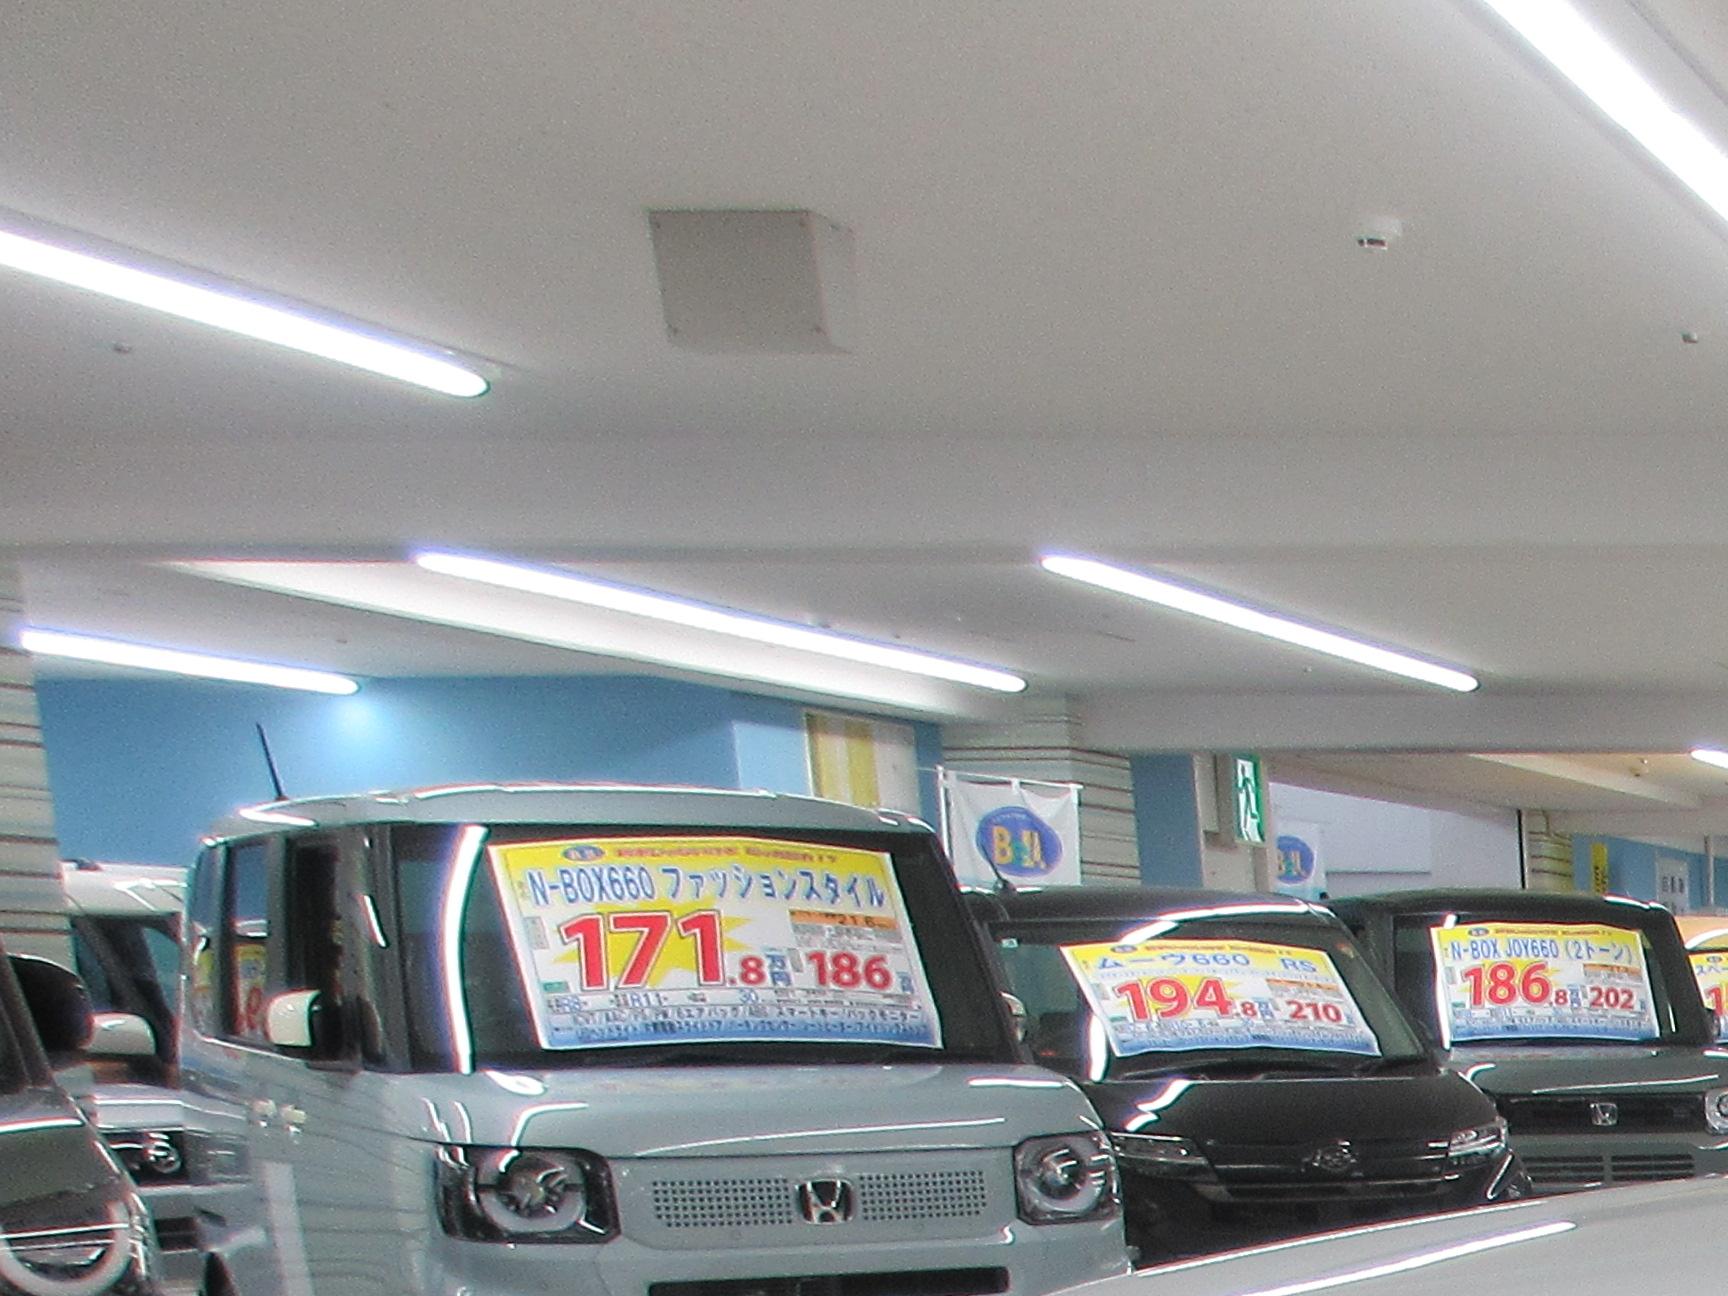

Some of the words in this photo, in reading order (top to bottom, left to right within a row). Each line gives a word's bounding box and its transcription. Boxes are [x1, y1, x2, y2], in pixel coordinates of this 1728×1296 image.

[527, 864, 656, 906] N-BOX660
[662, 864, 885, 908] ファッションスタイル
[1450, 941, 1502, 960] N-BOX
[1506, 939, 1559, 959] JOY660
[807, 951, 893, 991] 186
[1280, 957, 1317, 973] RS
[1590, 986, 1635, 1011] 202
[1285, 1000, 1343, 1022] 210
